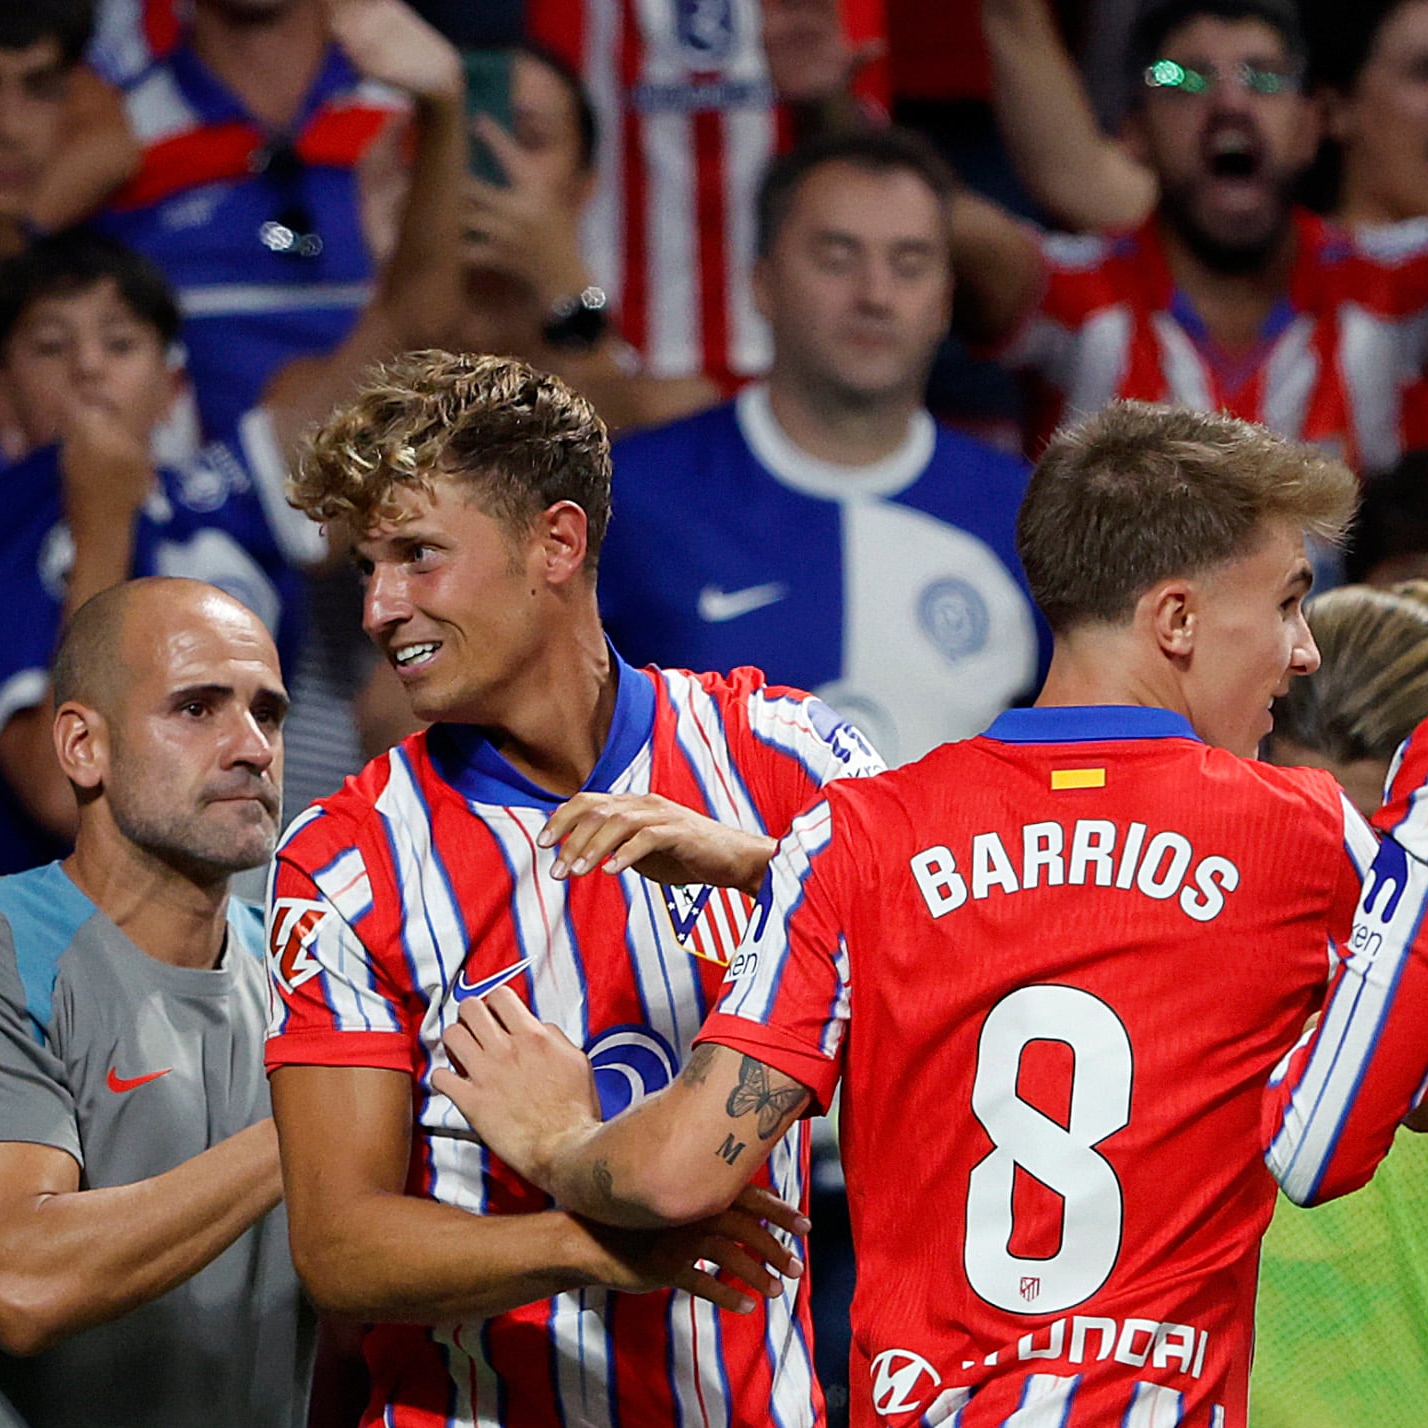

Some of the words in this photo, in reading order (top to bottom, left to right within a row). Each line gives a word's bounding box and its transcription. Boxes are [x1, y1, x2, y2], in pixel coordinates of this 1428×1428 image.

[909, 819, 1241, 922] BARRIOS
[728, 952, 759, 977] en
[964, 984, 1134, 1315] 8
[961, 1316, 1209, 1379] UNDAI
